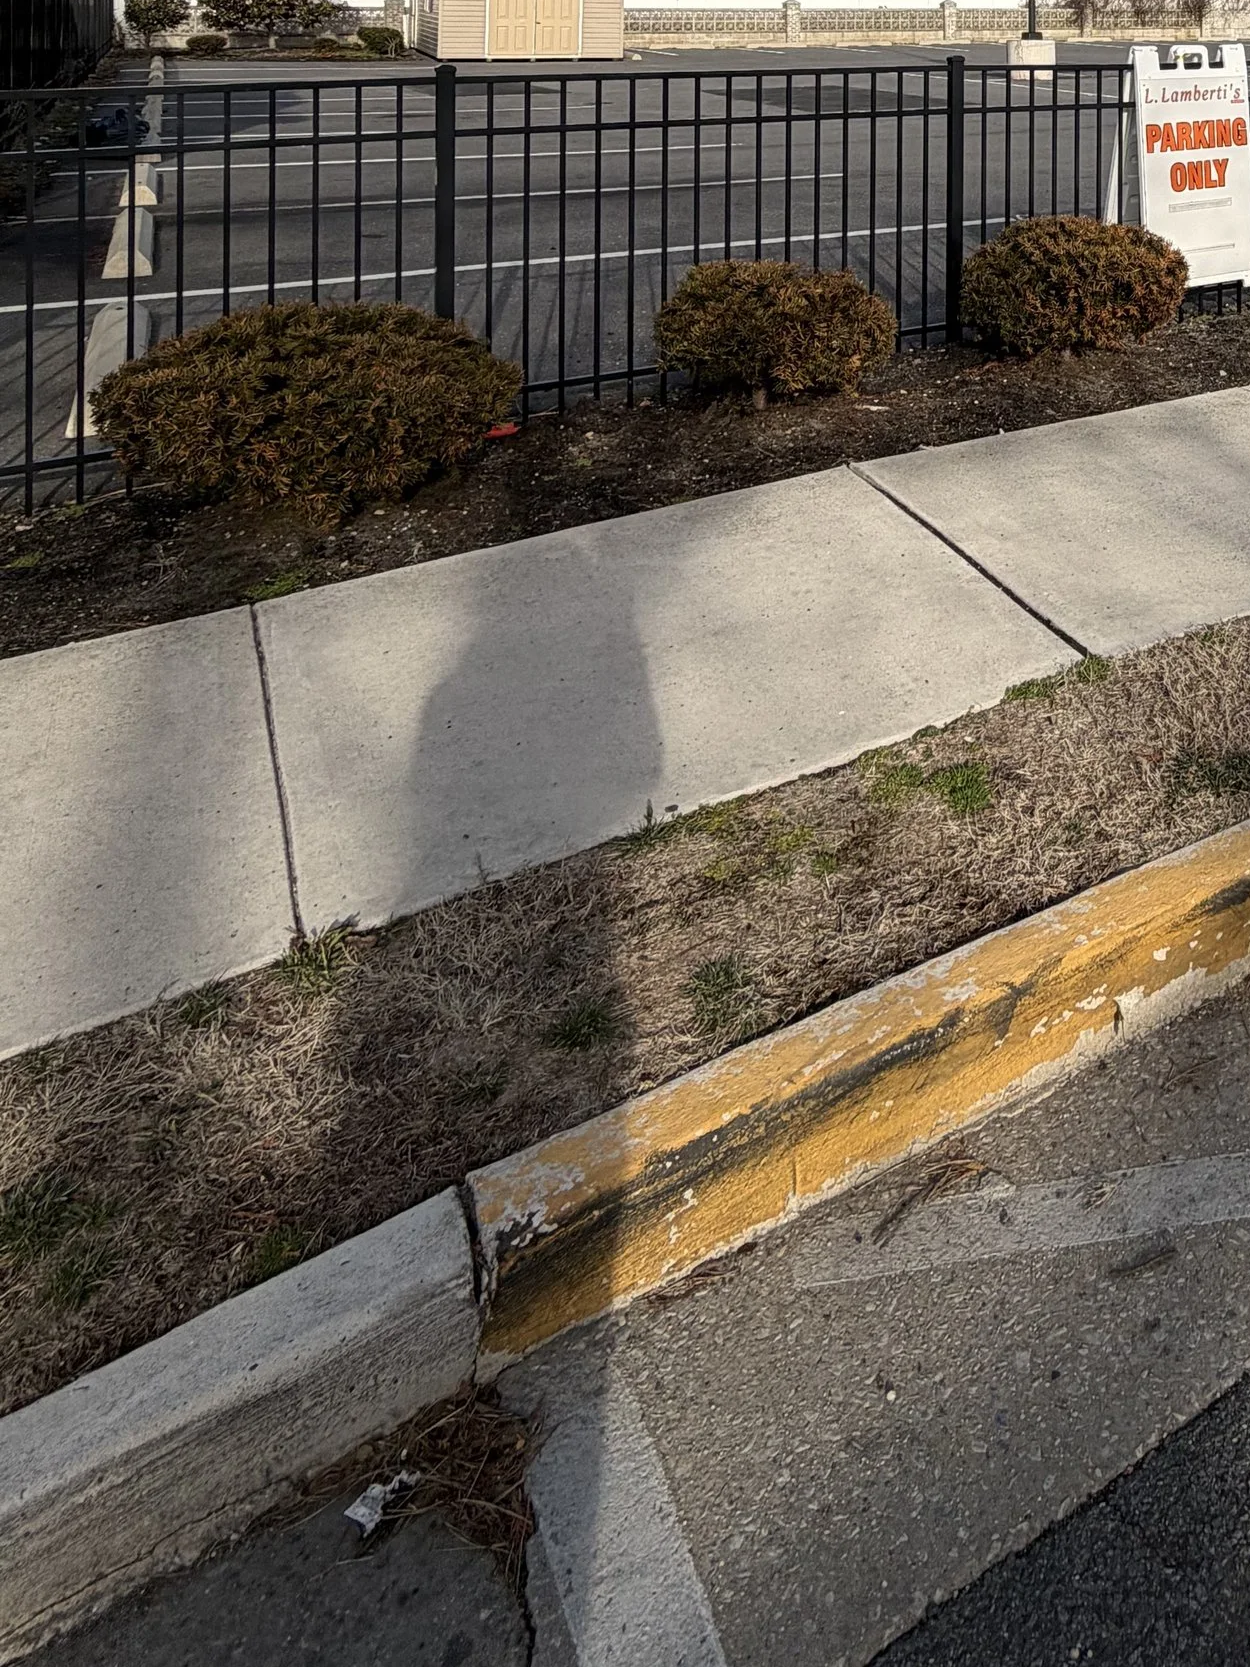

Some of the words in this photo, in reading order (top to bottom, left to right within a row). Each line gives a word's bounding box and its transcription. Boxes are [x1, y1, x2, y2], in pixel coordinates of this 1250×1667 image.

[1145, 88, 1158, 104] L.
[1161, 83, 1241, 103] Lamberti's
[1145, 117, 1248, 154] PARKING
[1170, 158, 1230, 193] ONLY
